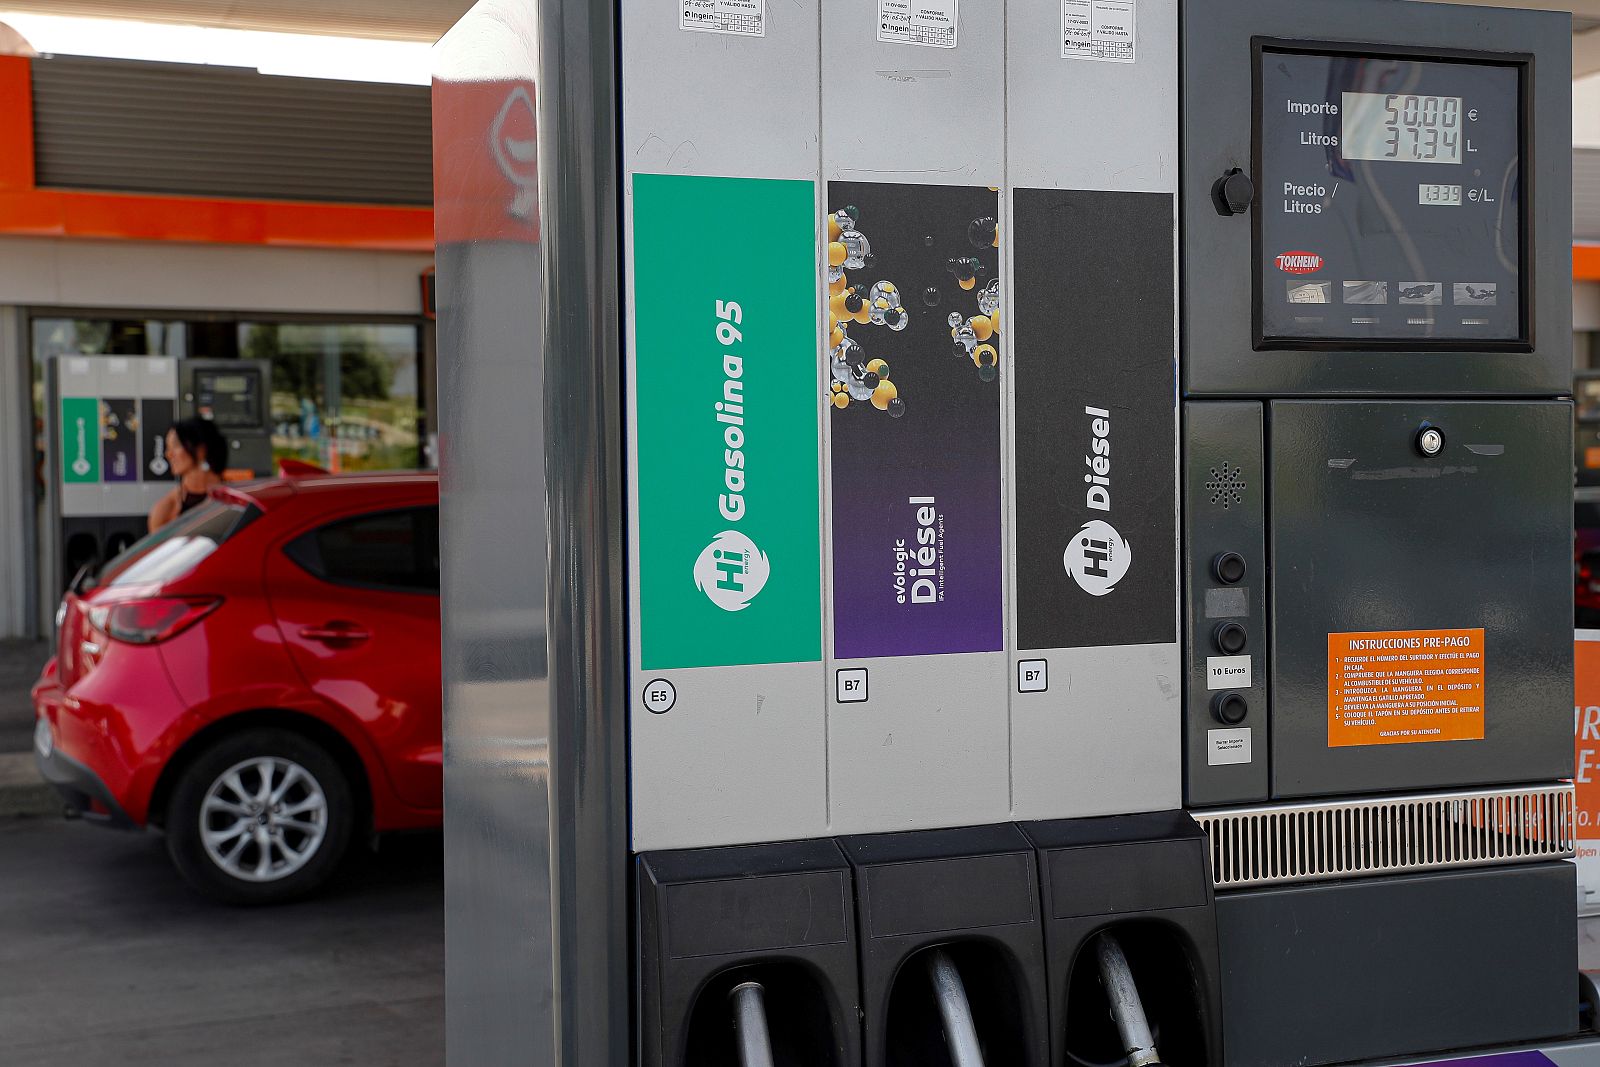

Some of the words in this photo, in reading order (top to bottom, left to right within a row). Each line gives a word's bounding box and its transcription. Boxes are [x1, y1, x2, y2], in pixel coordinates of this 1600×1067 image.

[691, 11, 714, 20] Ingein
[888, 24, 909, 32] Ingein
[1071, 41, 1091, 49] Ingein
[1287, 99, 1338, 116] Importe
[1467, 109, 1478, 121] €
[1300, 132, 1338, 146] Litros
[1384, 127, 1458, 160] 37,34
[1467, 140, 1478, 152] L.
[1284, 182, 1326, 197] Precio
[1467, 188, 1495, 202] €/L.
[1284, 200, 1322, 214] Litros
[1276, 255, 1320, 270] TOKHEIM
[715, 299, 743, 346] 95
[715, 354, 745, 522] Gasolina
[1084, 405, 1110, 512] Diésel
[909, 496, 937, 604] Diésel
[743, 548, 751, 575] energy
[1081, 537, 1108, 578] Hi
[713, 549, 744, 593] Hi
[1349, 638, 1421, 650] INSTRUCCIONES
[1423, 636, 1470, 648] PRE-PAGO
[1025, 670, 1040, 682] B7
[1212, 667, 1222, 676] 10
[1224, 667, 1246, 675] Euros
[1375, 671, 1386, 679] QUE
[1445, 667, 1480, 675] CORRESPONDE
[844, 680, 860, 691] B7
[1392, 685, 1423, 693] MANGUERA
[1447, 682, 1473, 690] DEPÓSITO
[651, 690, 667, 702] E5
[1344, 695, 1372, 703] MANTENGA
[1344, 711, 1367, 719] COLOQUE
[1410, 707, 1434, 715] DEPÓSITO
